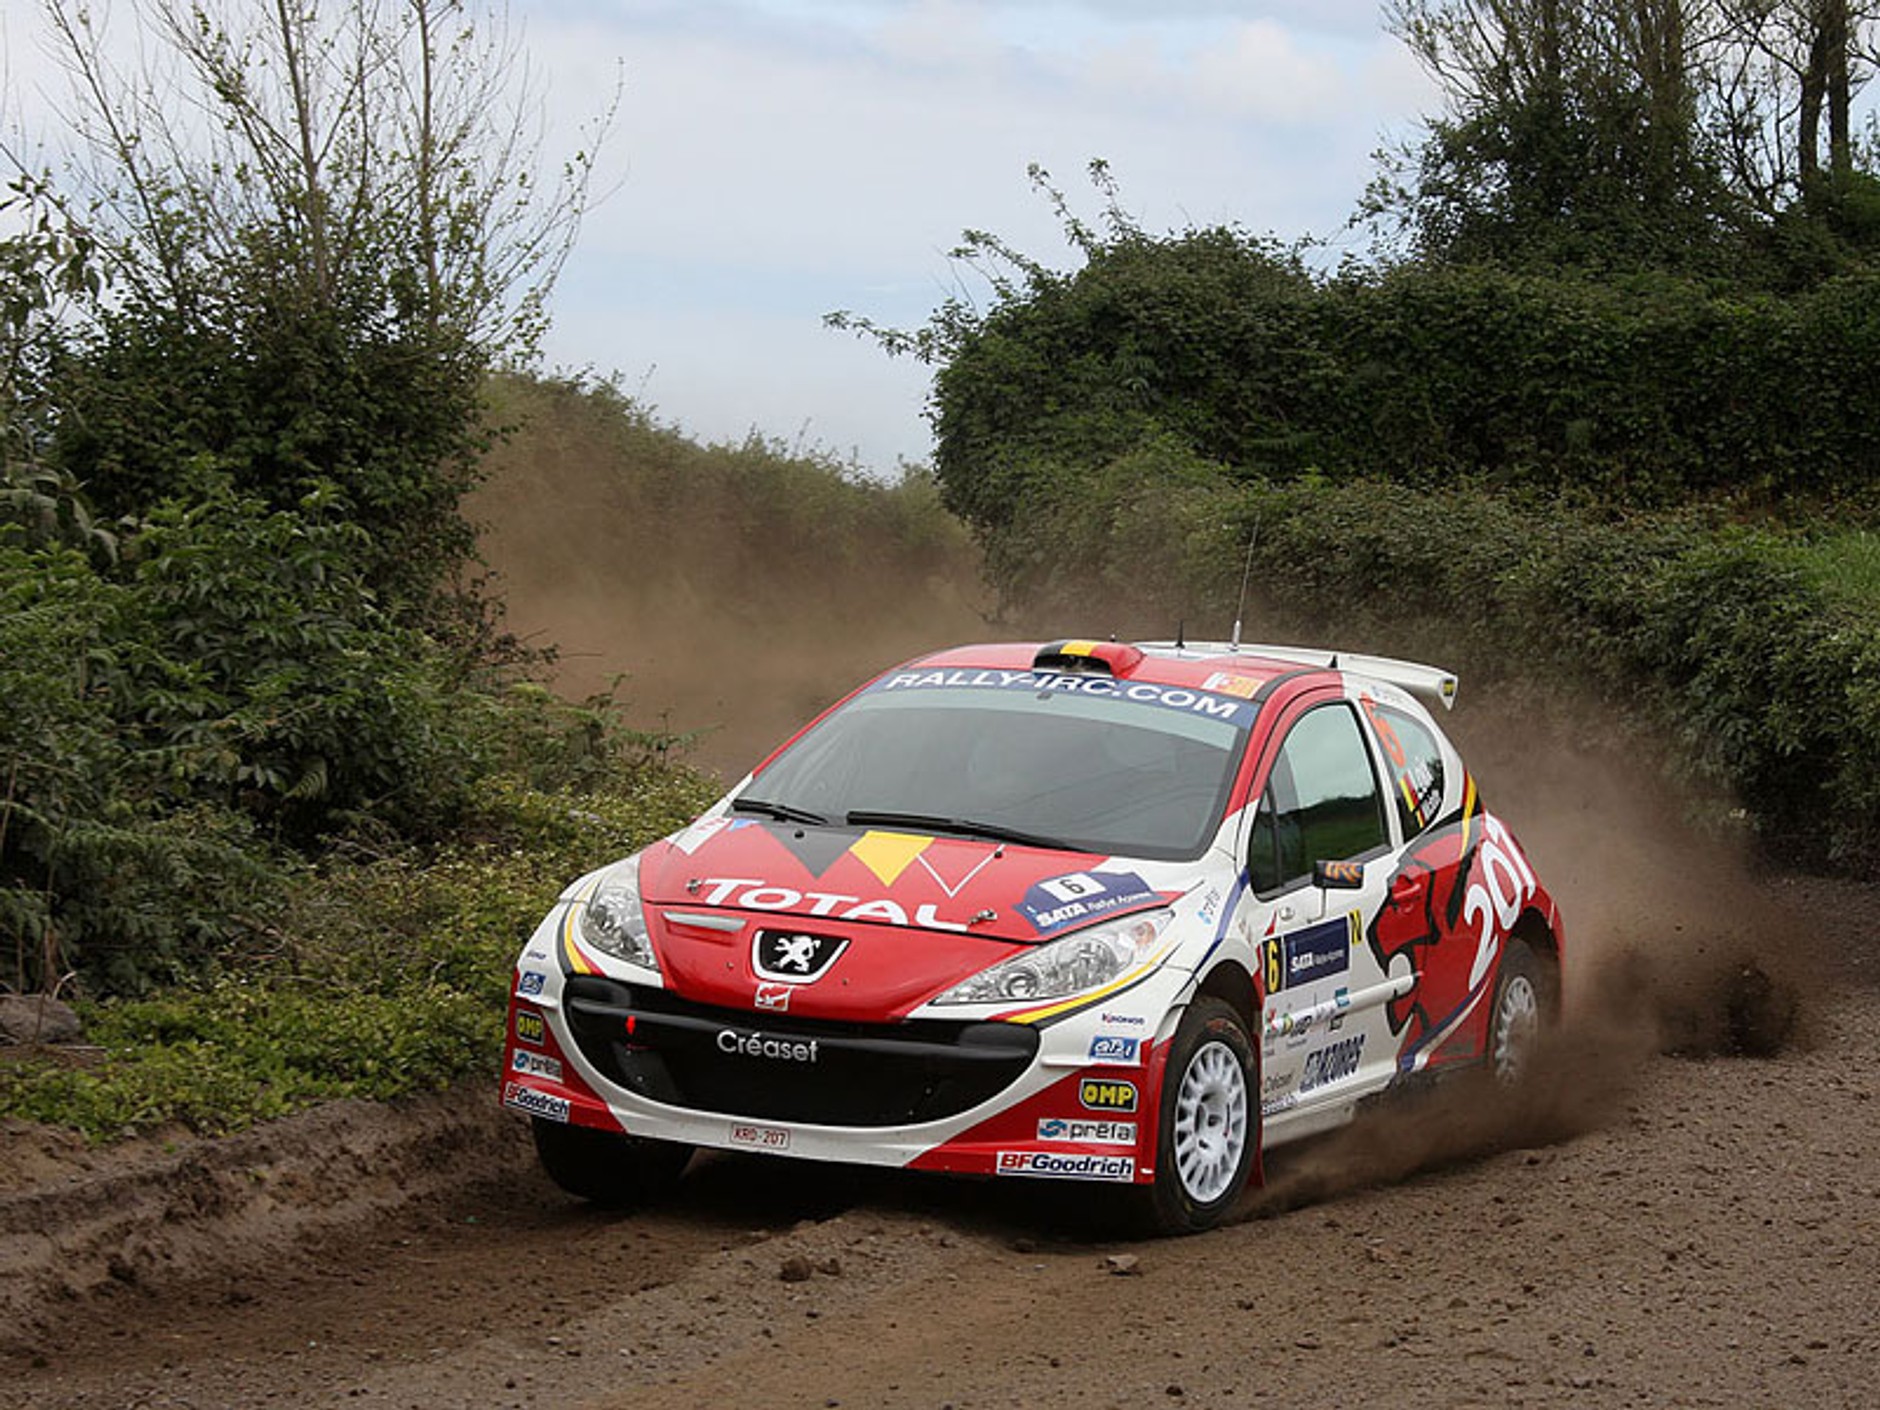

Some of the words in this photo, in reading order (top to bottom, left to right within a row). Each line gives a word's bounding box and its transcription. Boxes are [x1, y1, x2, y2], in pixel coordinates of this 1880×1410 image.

[884, 670, 1240, 719] RALLY-IRC.COM
[1059, 878, 1086, 895] 6
[703, 878, 969, 932] TOTAL
[1035, 901, 1088, 927] SATA
[1268, 940, 1280, 993] 6
[717, 1029, 819, 1063] Créaset
[1083, 1084, 1134, 1107] OMP
[1000, 1153, 1132, 1175] BFGoodrich
